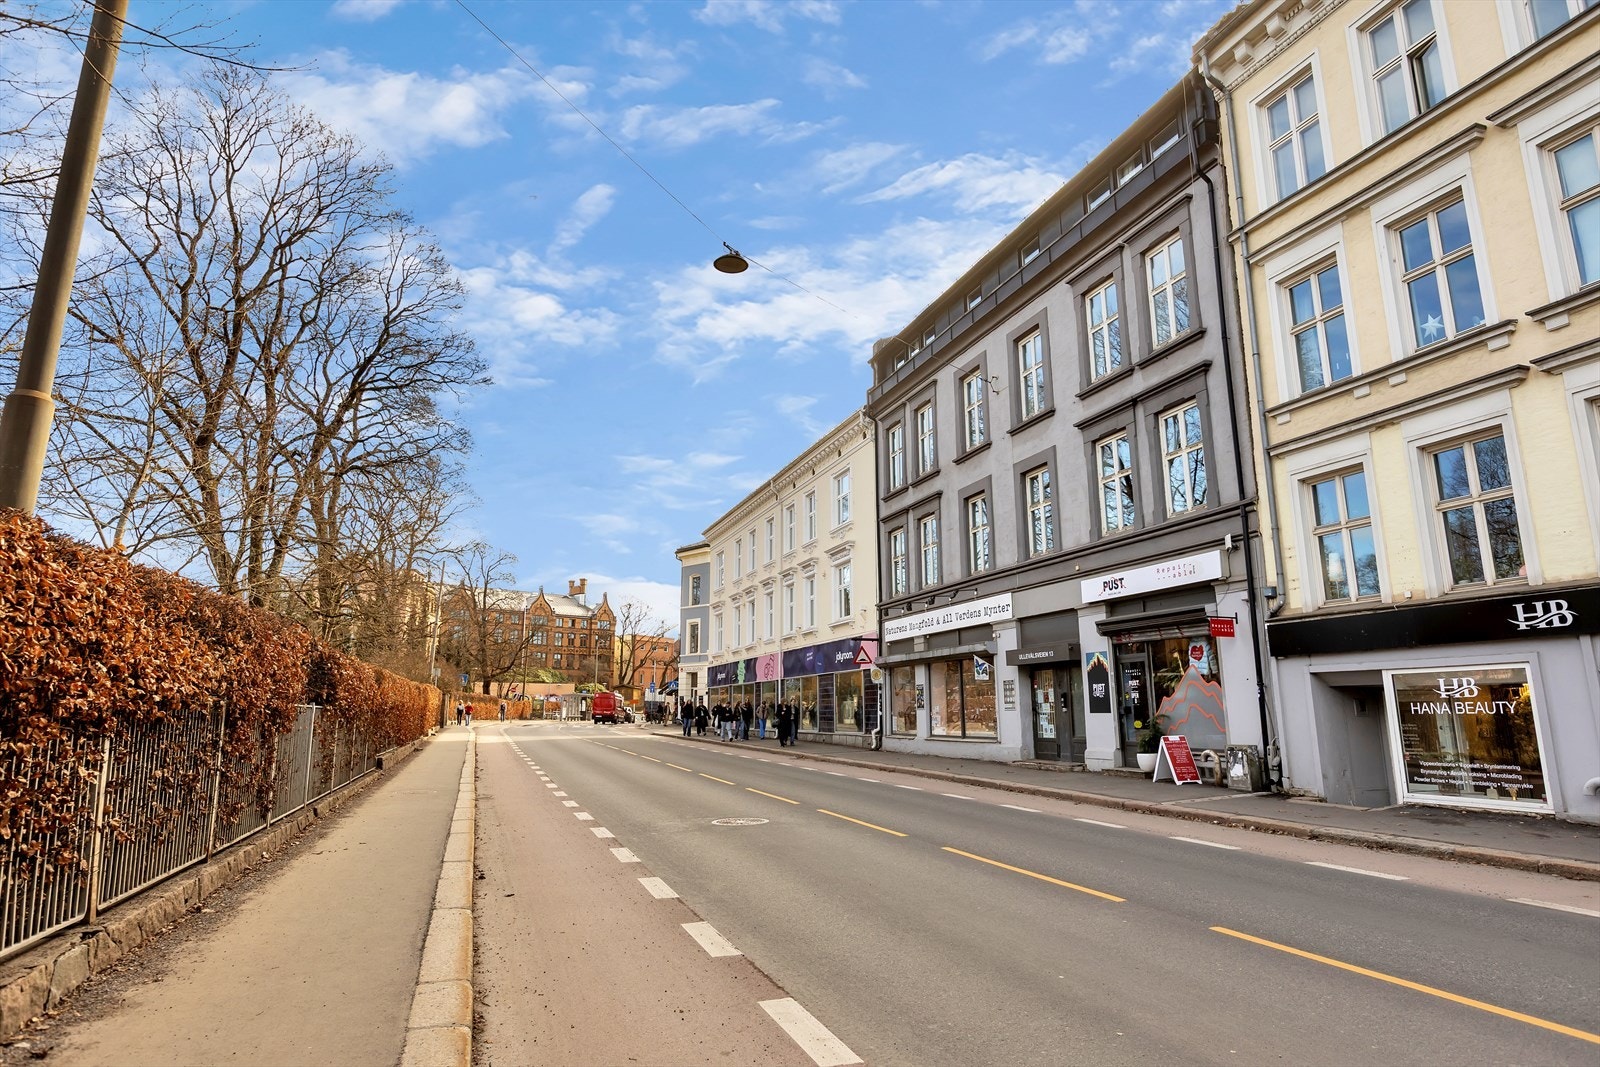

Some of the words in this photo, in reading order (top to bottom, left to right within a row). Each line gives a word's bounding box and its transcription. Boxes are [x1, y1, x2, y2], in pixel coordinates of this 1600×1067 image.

[1103, 577, 1125, 592] PUST
[936, 617, 941, 625] &
[942, 613, 953, 624] All
[955, 609, 982, 621] Verdens
[983, 603, 1011, 617] Mynter
[1510, 599, 1575, 630] HB
[1436, 677, 1479, 698] HB
[1410, 702, 1452, 715] HANA
[1454, 701, 1517, 715] BEAUTY
[1490, 772, 1523, 780] Microblading
